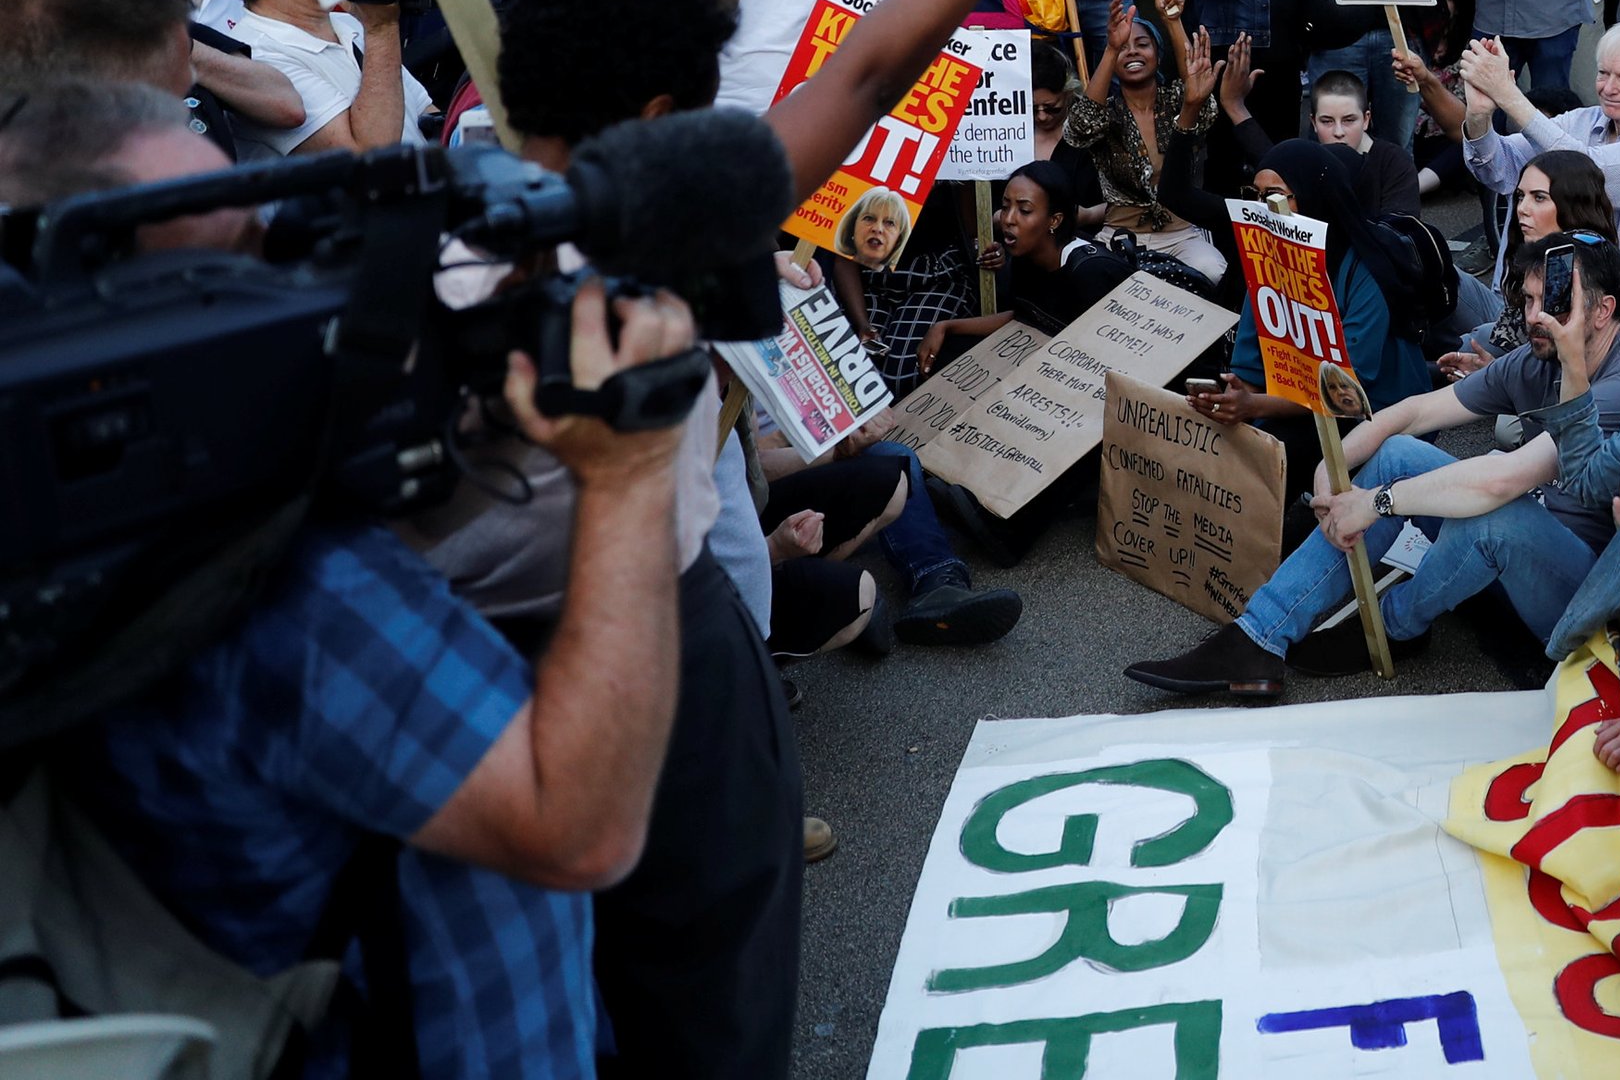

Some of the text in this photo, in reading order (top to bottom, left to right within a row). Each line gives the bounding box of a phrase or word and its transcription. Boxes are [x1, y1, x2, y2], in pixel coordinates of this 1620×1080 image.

[965, 123, 1026, 141] demand
[949, 145, 1014, 164] the truth
[1240, 226, 1318, 279] KICK THE
[1246, 252, 1330, 311] TORIES
[1104, 299, 1144, 327] TRAGEDY,
[1151, 324, 1175, 339] WAS
[1172, 332, 1185, 344] A
[1150, 295, 1204, 323] WAS NOT A
[1257, 286, 1343, 363] OUT!
[790, 307, 832, 366] MELTDOWN
[799, 288, 889, 409] DRIVE
[1096, 324, 1154, 357] CRIME!!
[1270, 345, 1292, 361] Fight
[790, 345, 843, 420] Socialist
[826, 362, 841, 380] IN
[1036, 361, 1068, 384] THERE
[1065, 373, 1096, 393] MUST
[1274, 360, 1288, 372] and
[1275, 373, 1297, 390] Back
[836, 377, 863, 416] TORIES
[905, 392, 940, 416] ON
[986, 400, 1056, 442] (@DavidLammy)
[1117, 397, 1222, 457] UNREALISTIC
[1109, 443, 1242, 514] CONFIMED FATALITIES
[1132, 488, 1234, 547] STOP THE MEDIA
[1113, 520, 1196, 571] COVER UP!!
